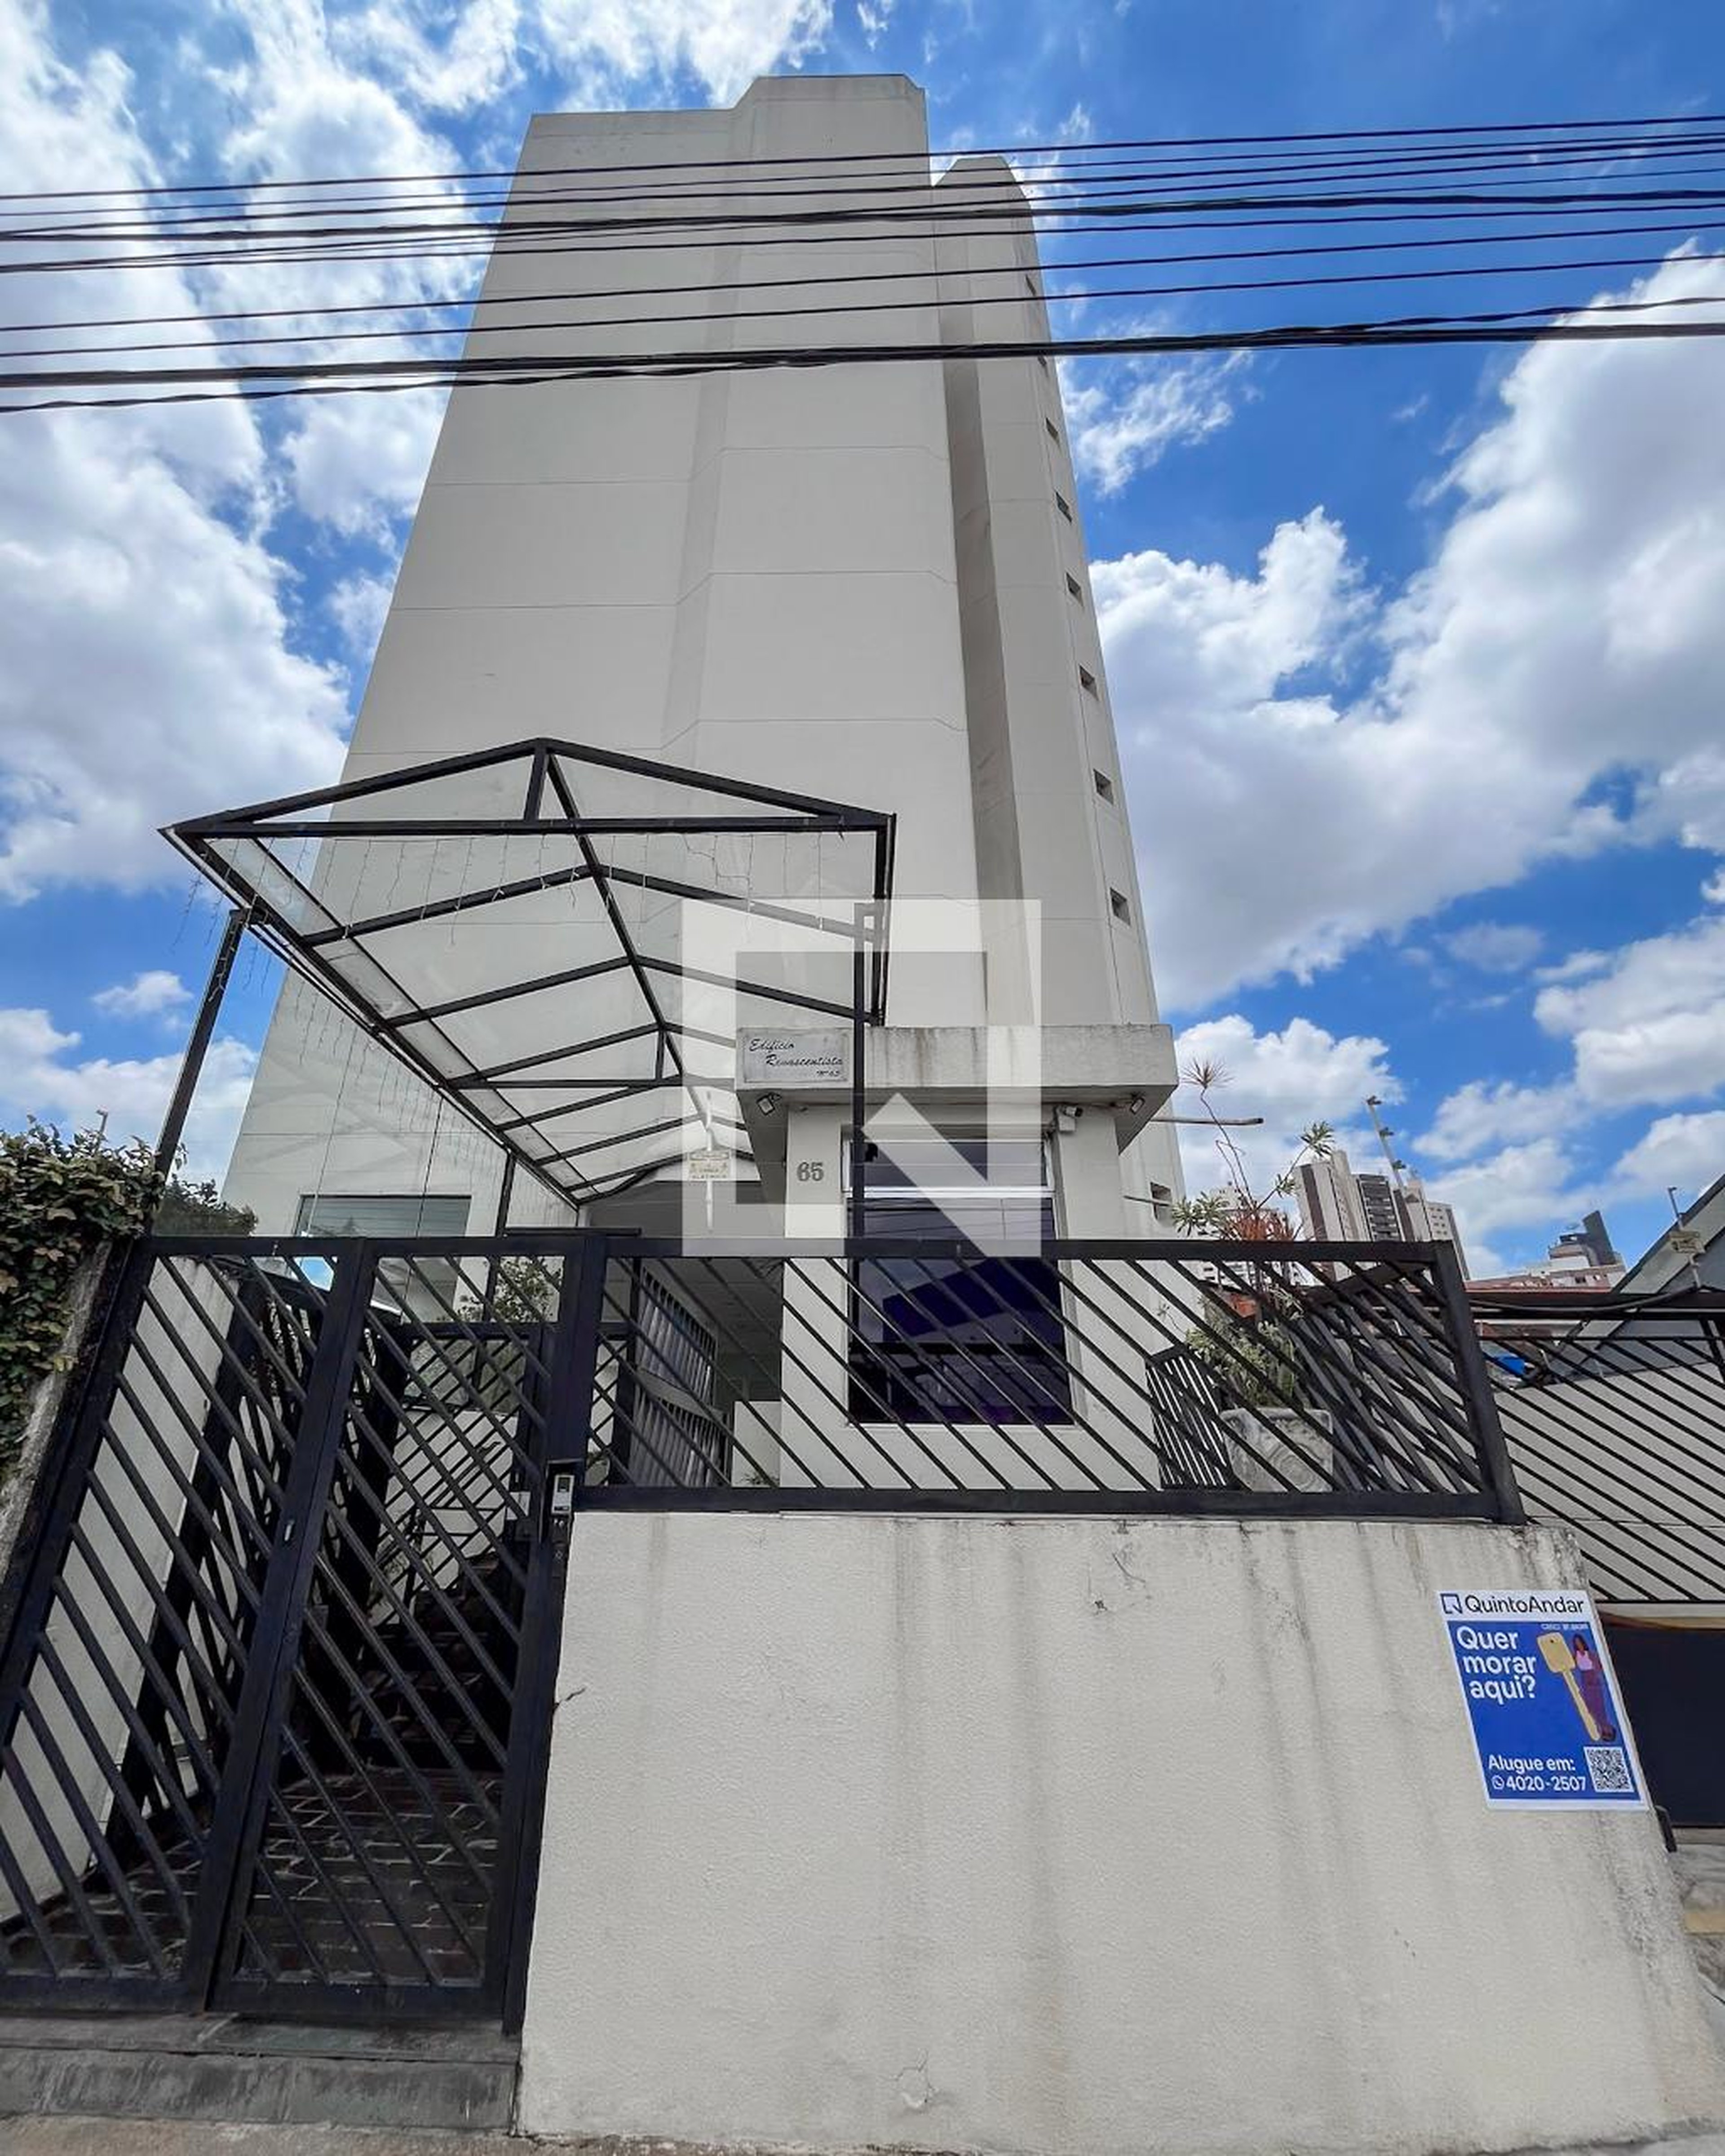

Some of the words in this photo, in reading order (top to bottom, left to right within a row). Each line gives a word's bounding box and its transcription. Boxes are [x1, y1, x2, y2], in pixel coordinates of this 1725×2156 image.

[796, 1162, 824, 1181] 65
[1465, 1595, 1584, 1613] QuintoAndar
[1456, 1626, 1518, 1650] Quer
[1463, 1656, 1537, 1674] morar
[1469, 1674, 1536, 1705] aqui?
[1489, 1754, 1544, 1774] Alugue
[1546, 1758, 1576, 1771] em:
[1506, 1776, 1586, 1791] 4020-2507
